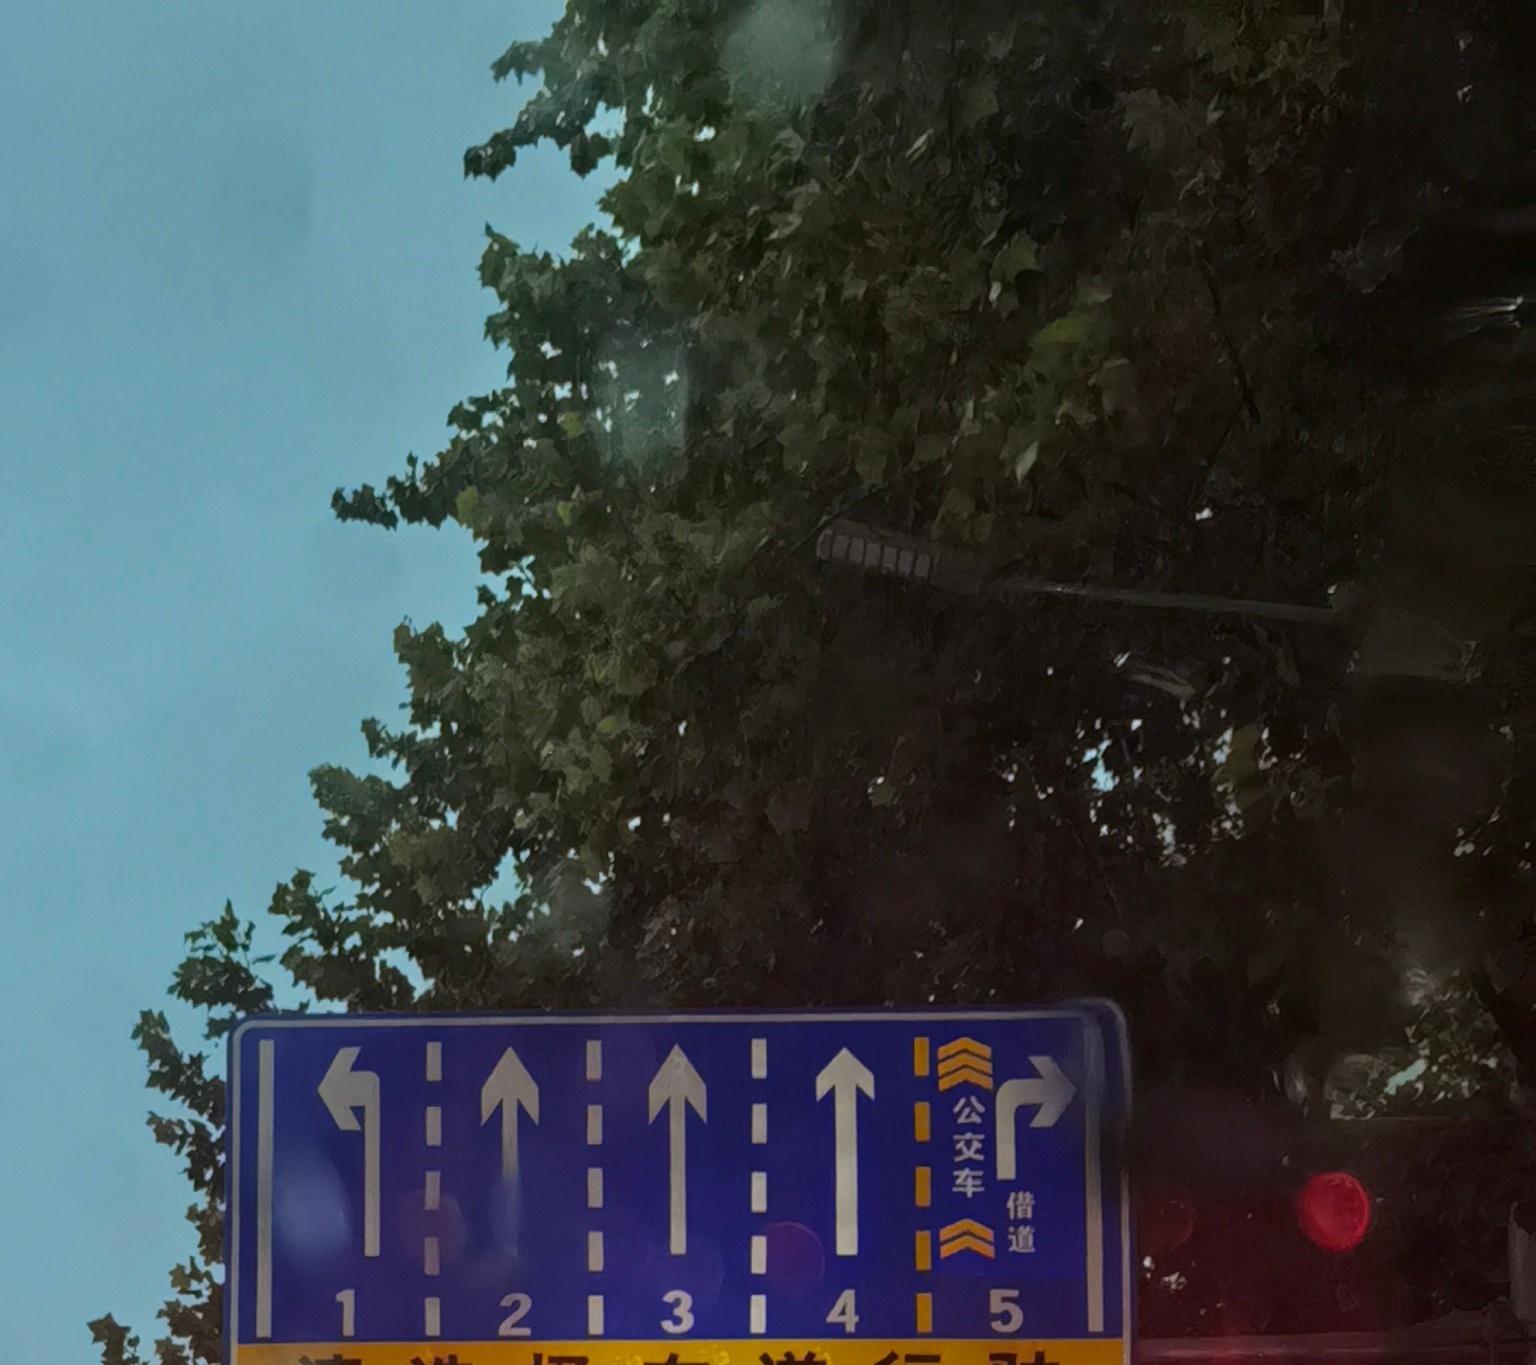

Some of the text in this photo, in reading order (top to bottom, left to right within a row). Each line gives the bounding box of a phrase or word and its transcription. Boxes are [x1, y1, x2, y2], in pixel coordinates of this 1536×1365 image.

[951, 1095, 986, 1198] 公交车
[1006, 1191, 1036, 1254] 借道
[335, 1288, 1024, 1337] 1 2 3 4 5
